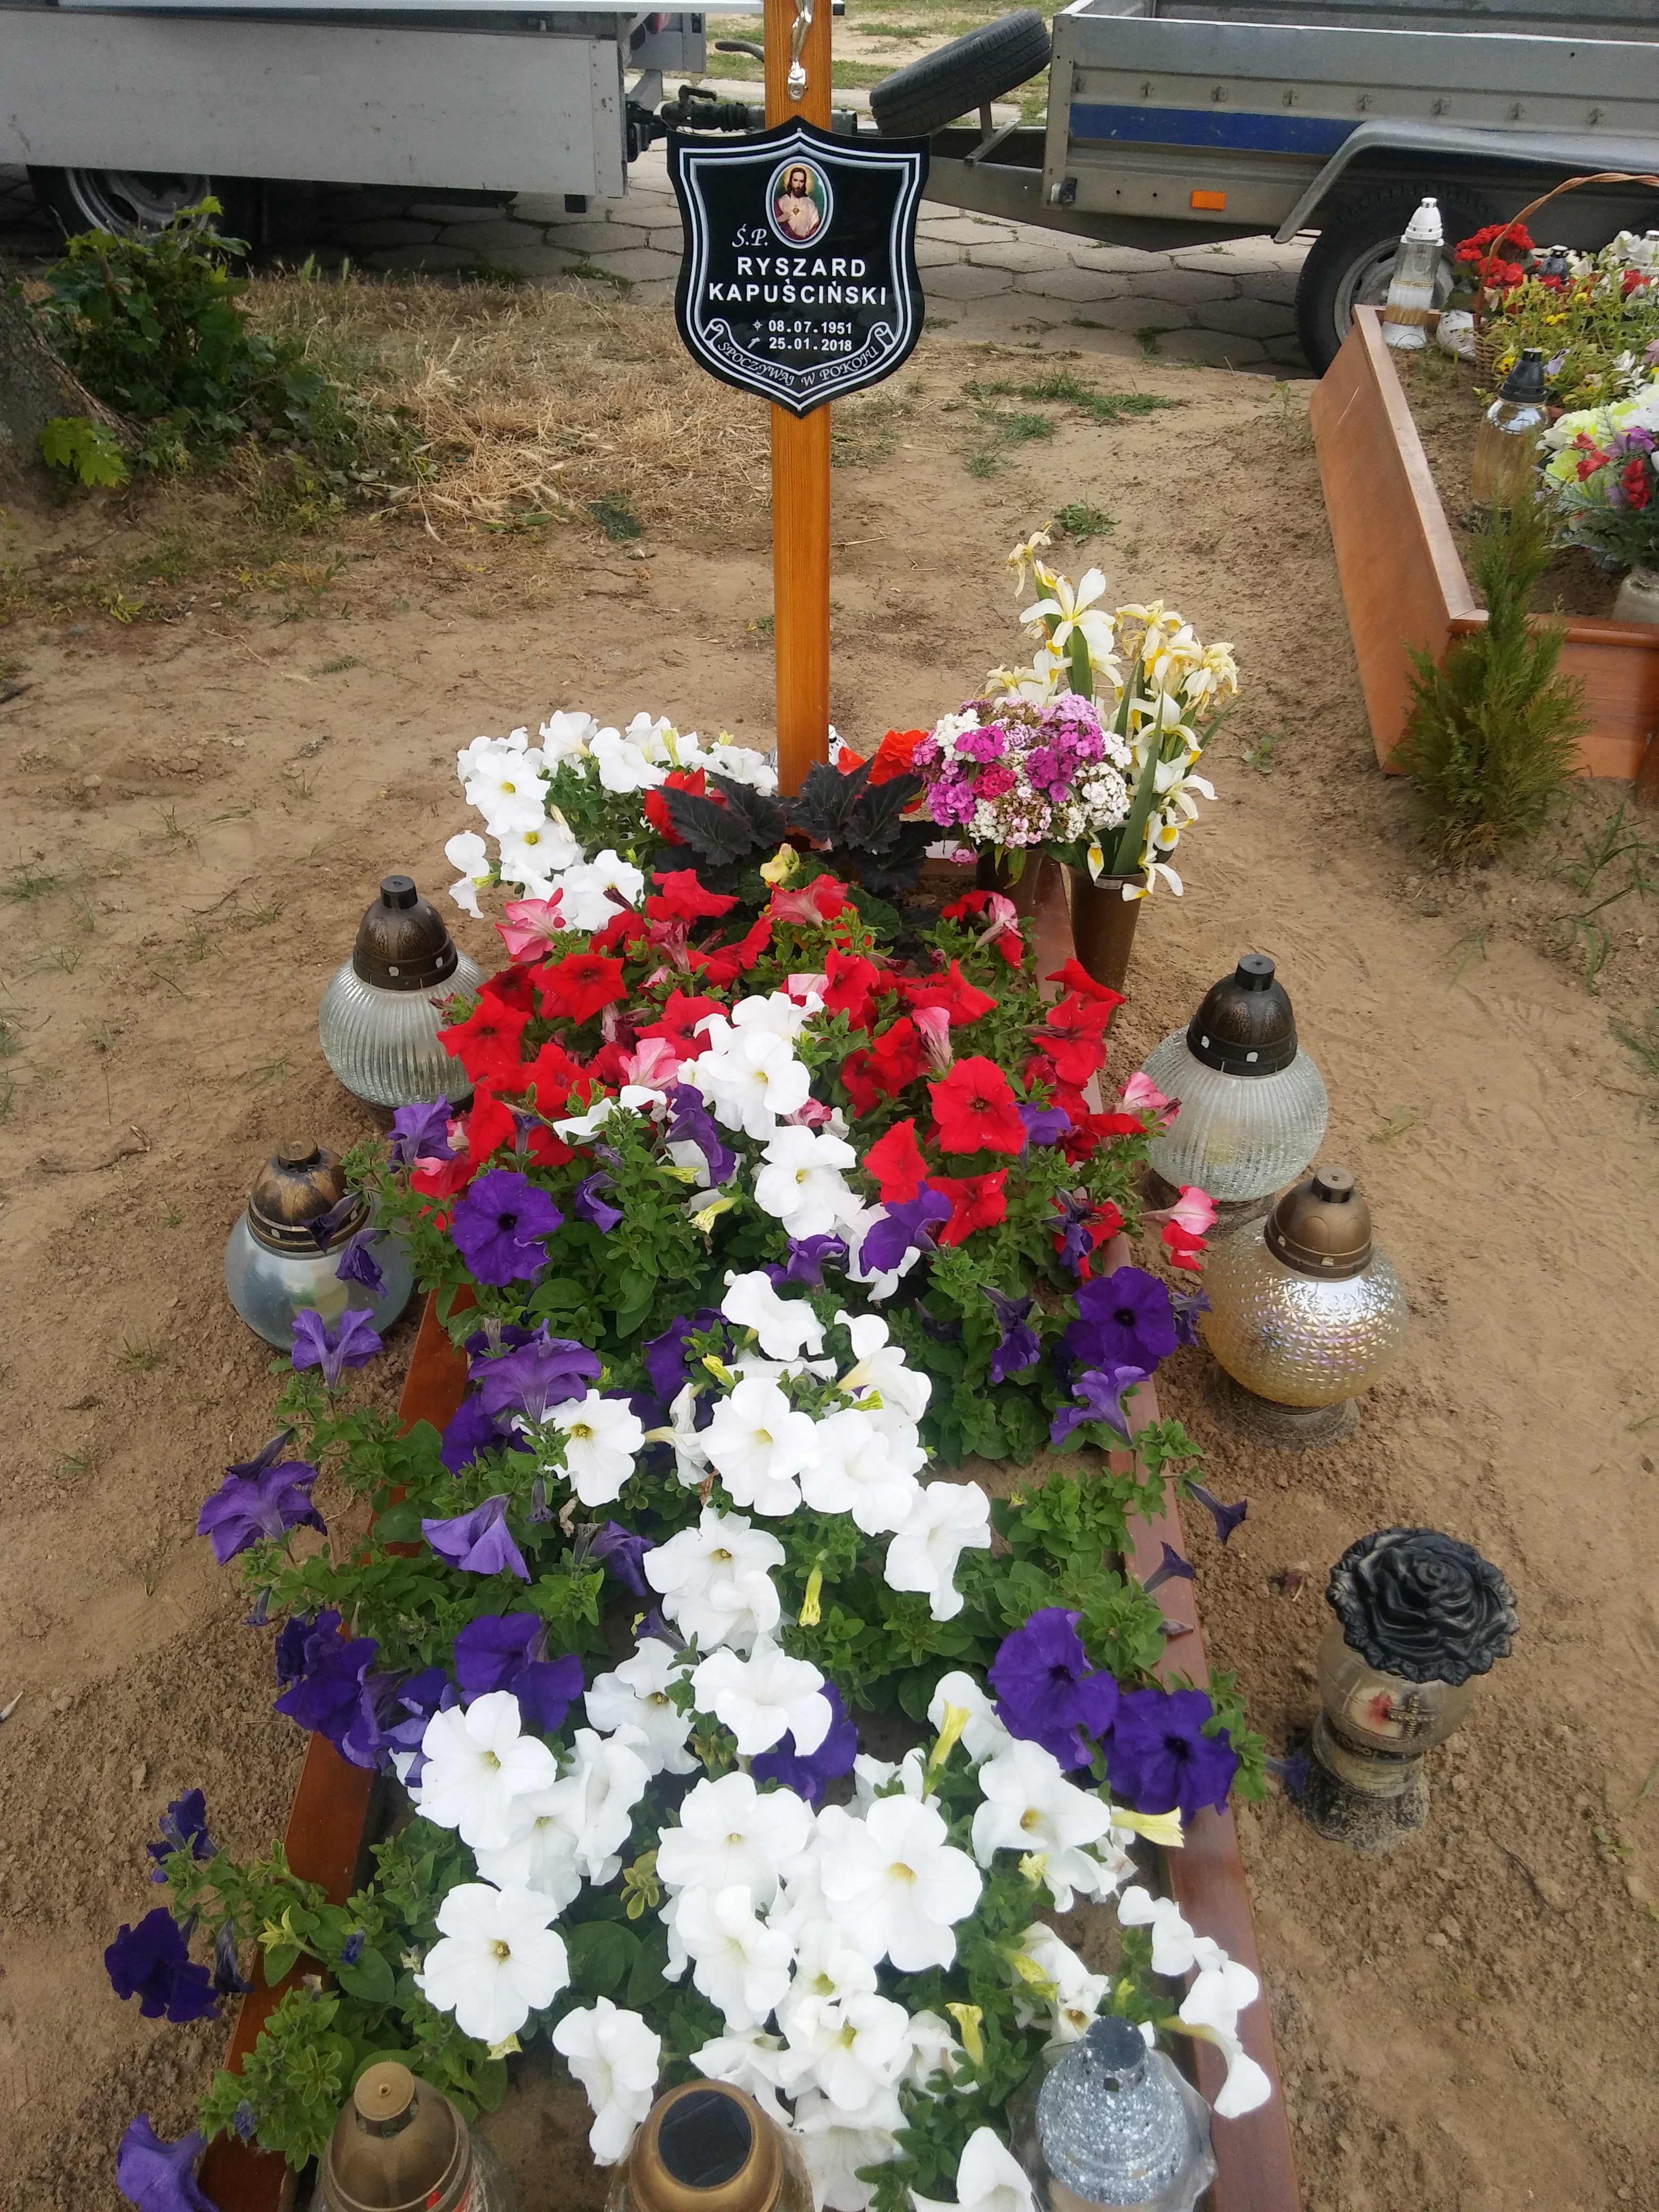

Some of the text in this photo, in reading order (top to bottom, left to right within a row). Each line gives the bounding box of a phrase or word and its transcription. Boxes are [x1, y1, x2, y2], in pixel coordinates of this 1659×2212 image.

[737, 256, 866, 277] RYSZARD
[709, 278, 886, 305] KAPUŚCIŃSKI
[768, 320, 852, 334] 08.07.1951
[769, 337, 852, 352] 25.01.2018
[717, 342, 879, 387] SPOCZYWAJ W POKOJU
